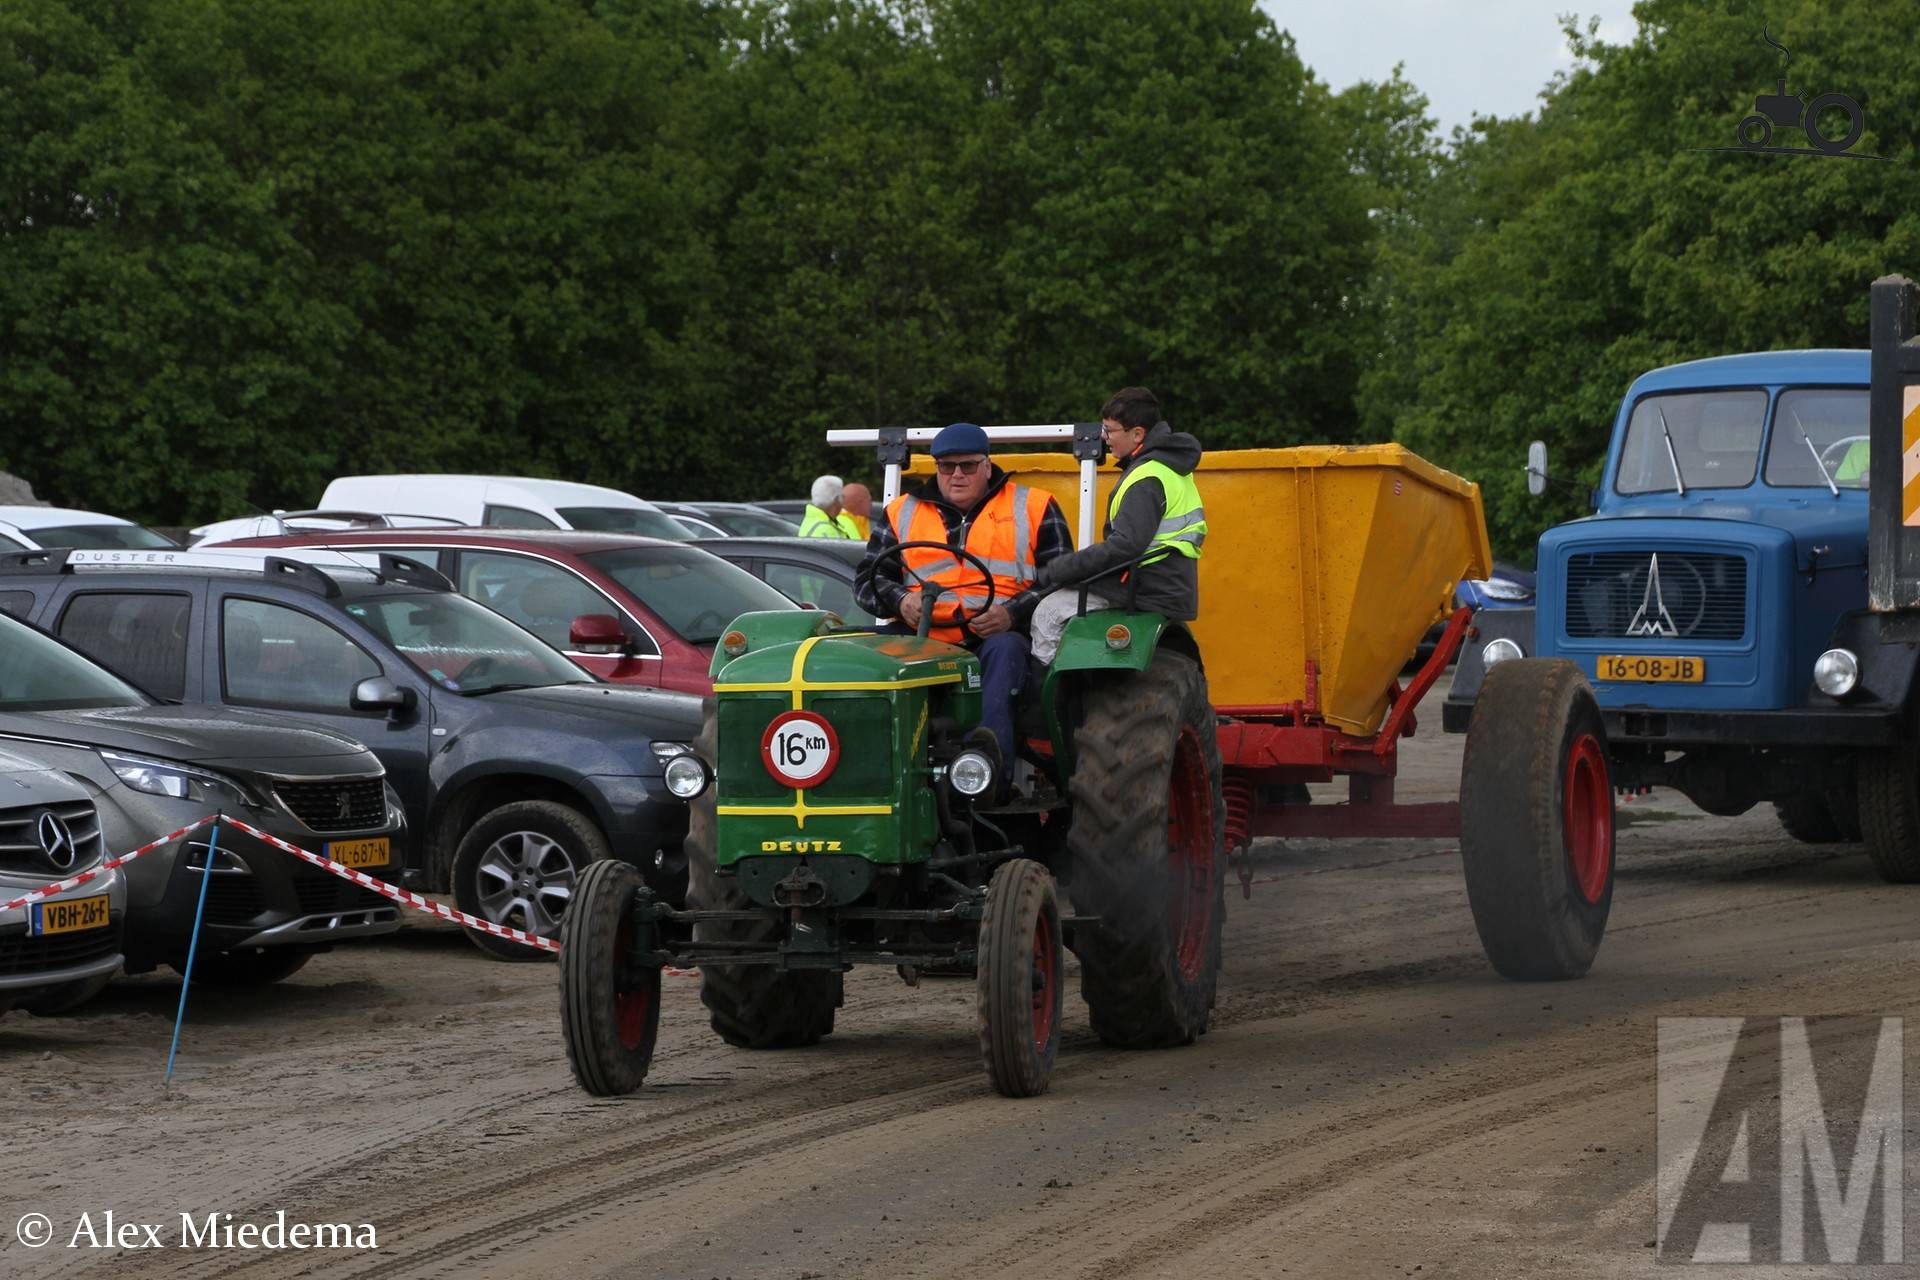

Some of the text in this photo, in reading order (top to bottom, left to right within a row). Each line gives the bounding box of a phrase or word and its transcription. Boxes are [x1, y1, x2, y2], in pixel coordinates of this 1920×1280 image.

[75, 552, 175, 562] DUSTER
[1607, 659, 1694, 679] 16-08-JB
[778, 732, 807, 766] 16
[334, 842, 386, 865] XL-687-N
[761, 841, 842, 853] DEUTZ
[47, 900, 106, 928] VBH-26-F
